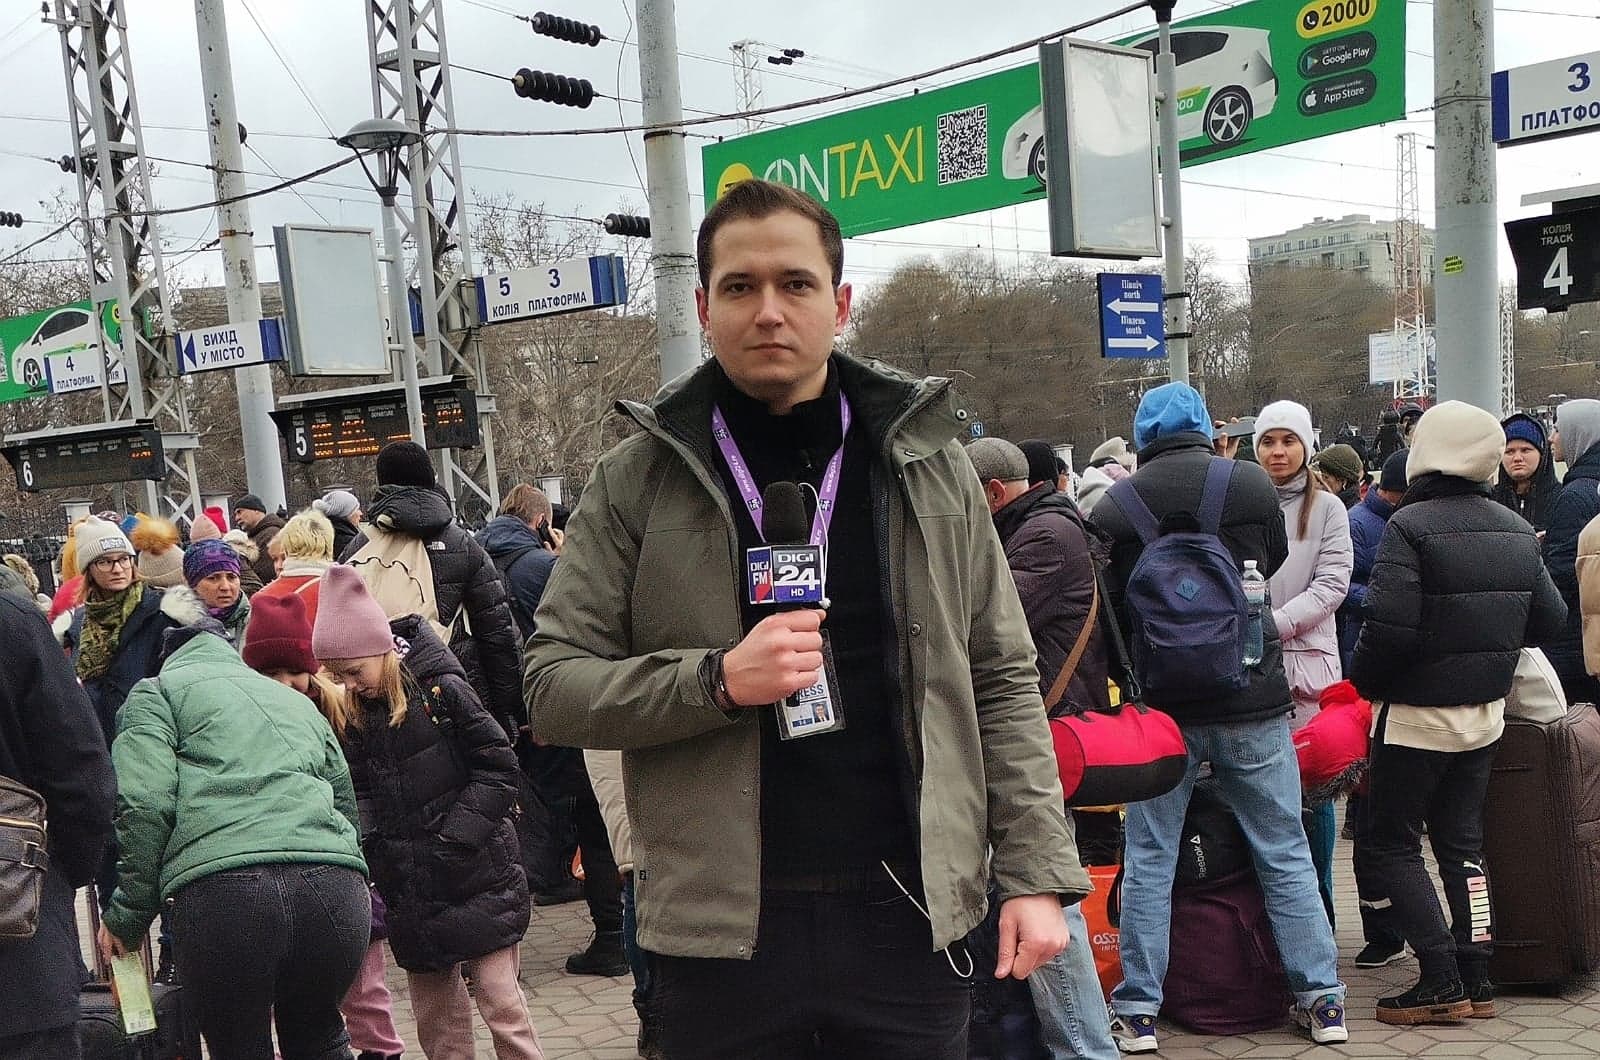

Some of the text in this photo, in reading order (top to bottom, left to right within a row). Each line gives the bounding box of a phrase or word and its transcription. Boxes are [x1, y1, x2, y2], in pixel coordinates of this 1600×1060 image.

[1321, 0, 1370, 27] 2000
[1322, 47, 1370, 65] Google Play
[1567, 62, 1591, 92] 3
[1324, 87, 1365, 104] App Store
[1521, 101, 1600, 132] ПЛАТФО
[1543, 223, 1571, 235] КОЛІЯ
[1541, 233, 1574, 246] TRACK
[1543, 246, 1573, 295] 4
[499, 268, 561, 296] 5 3
[492, 291, 587, 318] КОЛІЯ ПЛАТФОРМА
[203, 329, 238, 346] ВИХІД
[66, 356, 75, 371] 4
[201, 346, 245, 364] У МІСТО
[56, 375, 96, 389] ПЛАТФОРМА
[295, 427, 307, 456] 5
[23, 461, 33, 486] 6
[750, 561, 769, 571] DIGI
[778, 553, 814, 563] DIGI
[752, 571, 768, 586] FM
[774, 565, 820, 591] 24
[791, 588, 805, 596] HD
[798, 684, 824, 697] RESS
[1193, 844, 1207, 879] Reebok
[1467, 876, 1491, 942] PUMA
